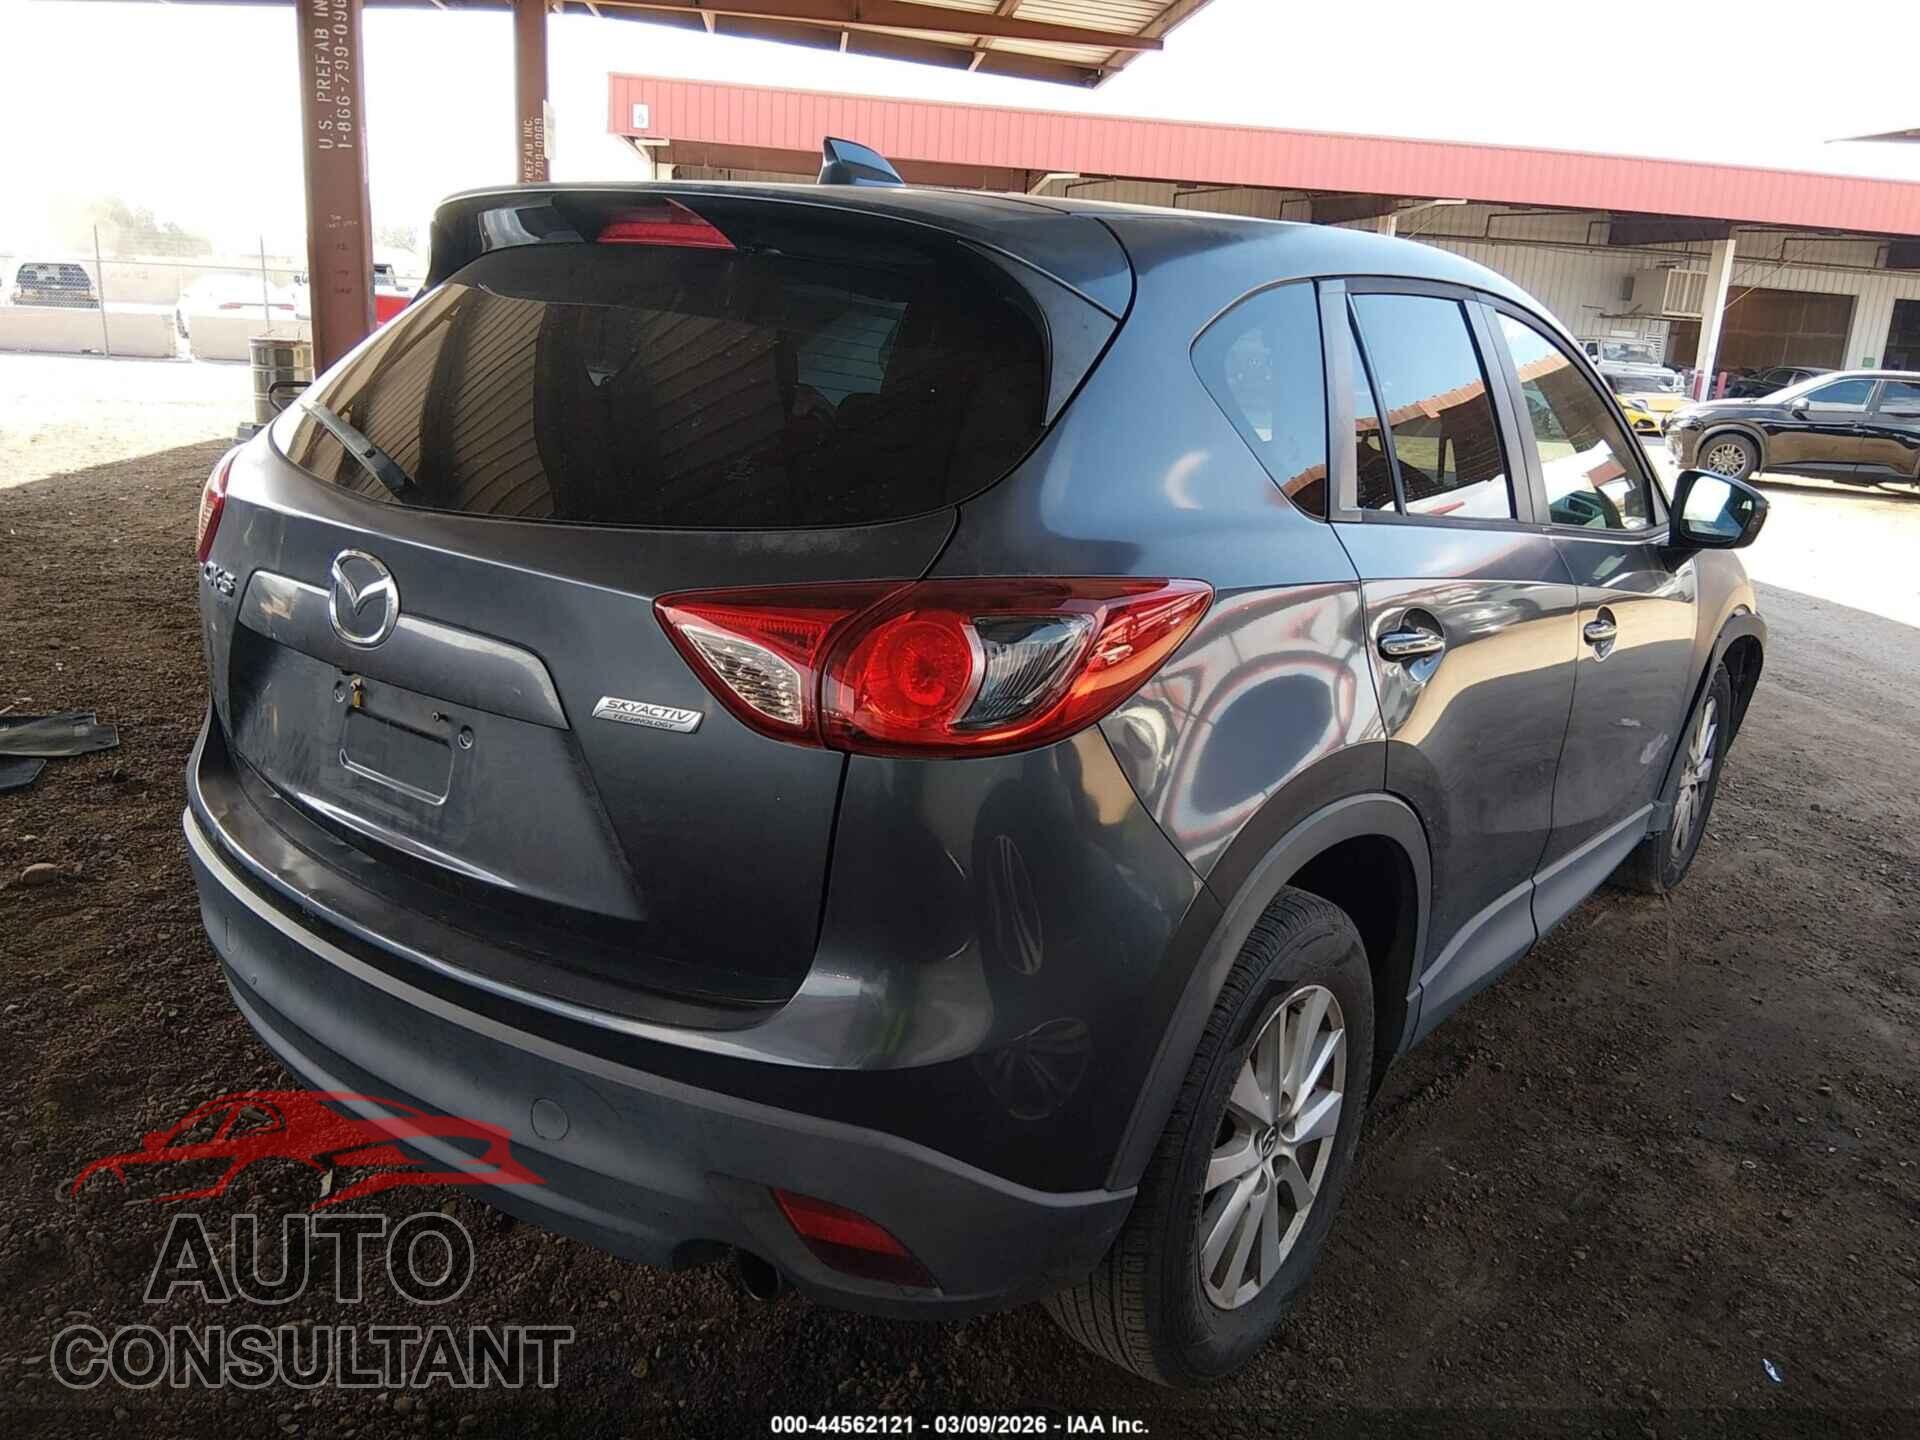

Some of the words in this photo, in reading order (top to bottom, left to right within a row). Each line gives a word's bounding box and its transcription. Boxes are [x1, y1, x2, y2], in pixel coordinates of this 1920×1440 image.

[314, 27, 333, 103] PREFAB
[318, 113, 334, 150] U.S.
[605, 699, 690, 721] SKYACTIV
[613, 713, 675, 729] TECHNOLOGY
